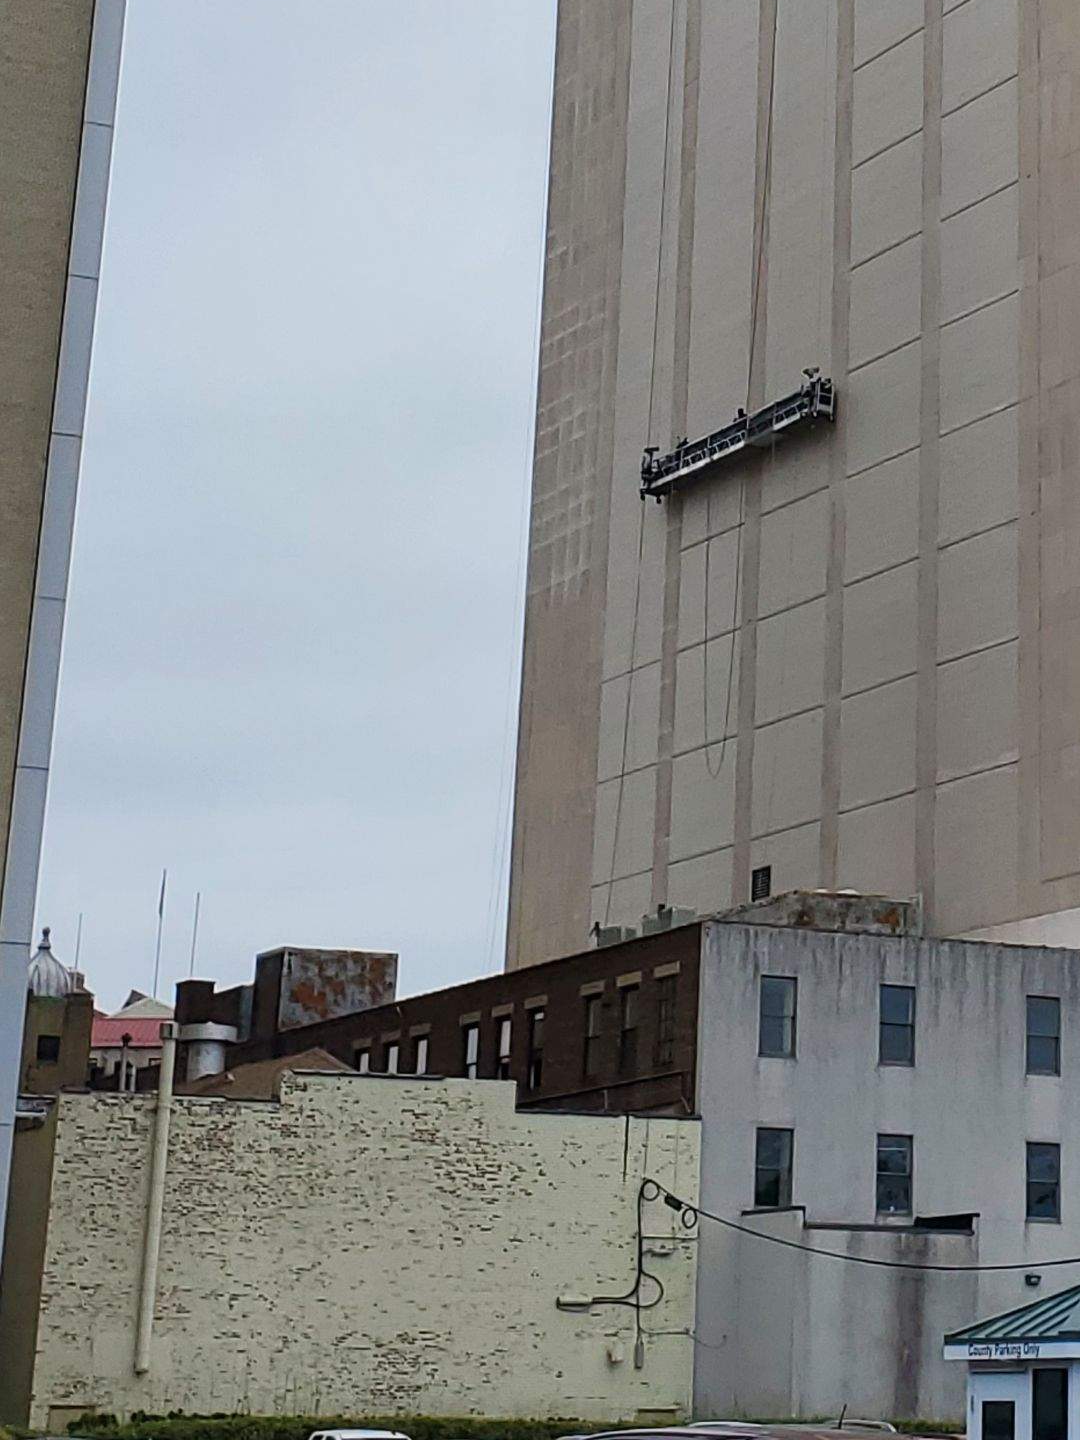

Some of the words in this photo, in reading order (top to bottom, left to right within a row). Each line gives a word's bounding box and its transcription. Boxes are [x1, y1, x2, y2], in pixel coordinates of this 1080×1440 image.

[968, 1343, 992, 1357] County
[995, 1343, 1021, 1358] Parking
[1023, 1343, 1039, 1357] Only
